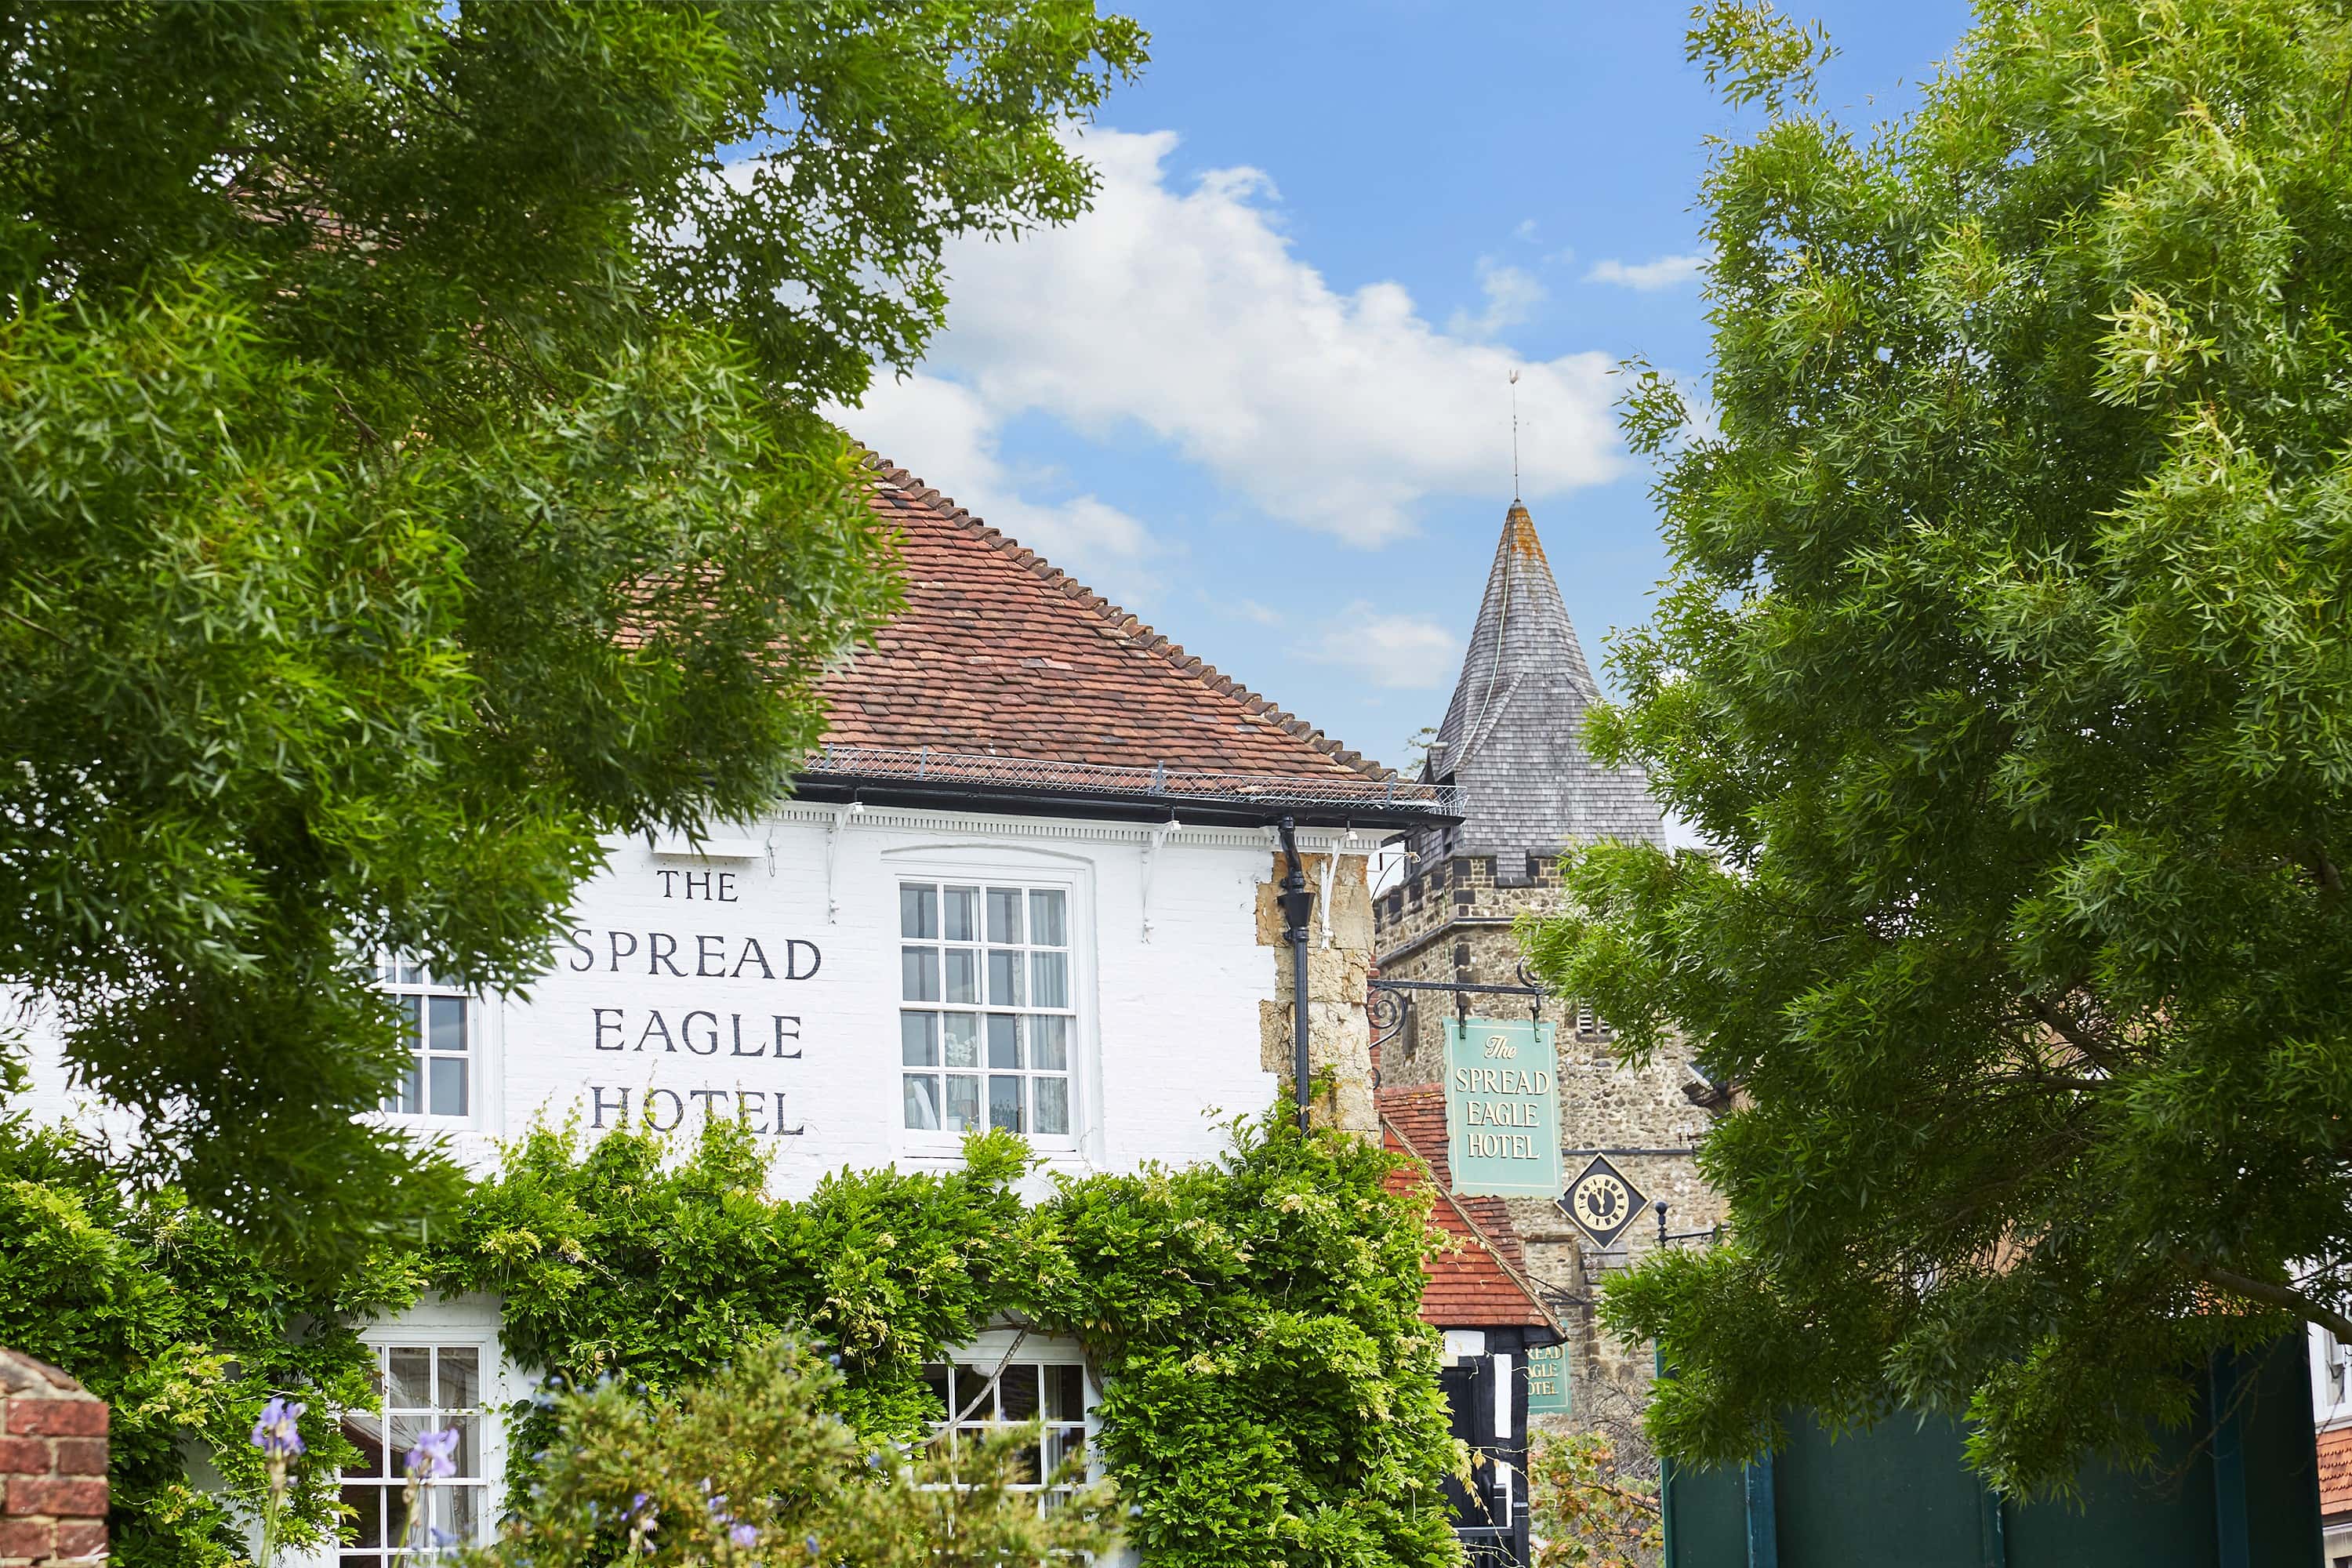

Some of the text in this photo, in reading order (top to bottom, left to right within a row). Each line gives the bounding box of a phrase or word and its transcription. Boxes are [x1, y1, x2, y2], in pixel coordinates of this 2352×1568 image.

[657, 869, 739, 902] THE
[570, 929, 822, 980] SPREAD
[592, 1007, 802, 1059] EAGLE
[1483, 1035, 1517, 1059] The
[1455, 1068, 1550, 1095] SPREAD
[590, 1086, 804, 1135] HOTEL
[1466, 1102, 1540, 1127] EAGLE
[1468, 1134, 1541, 1160] HOTEL
[1527, 1345, 1563, 1360] READ
[1528, 1363, 1559, 1378] AGLE
[1528, 1381, 1559, 1396] OTEL
